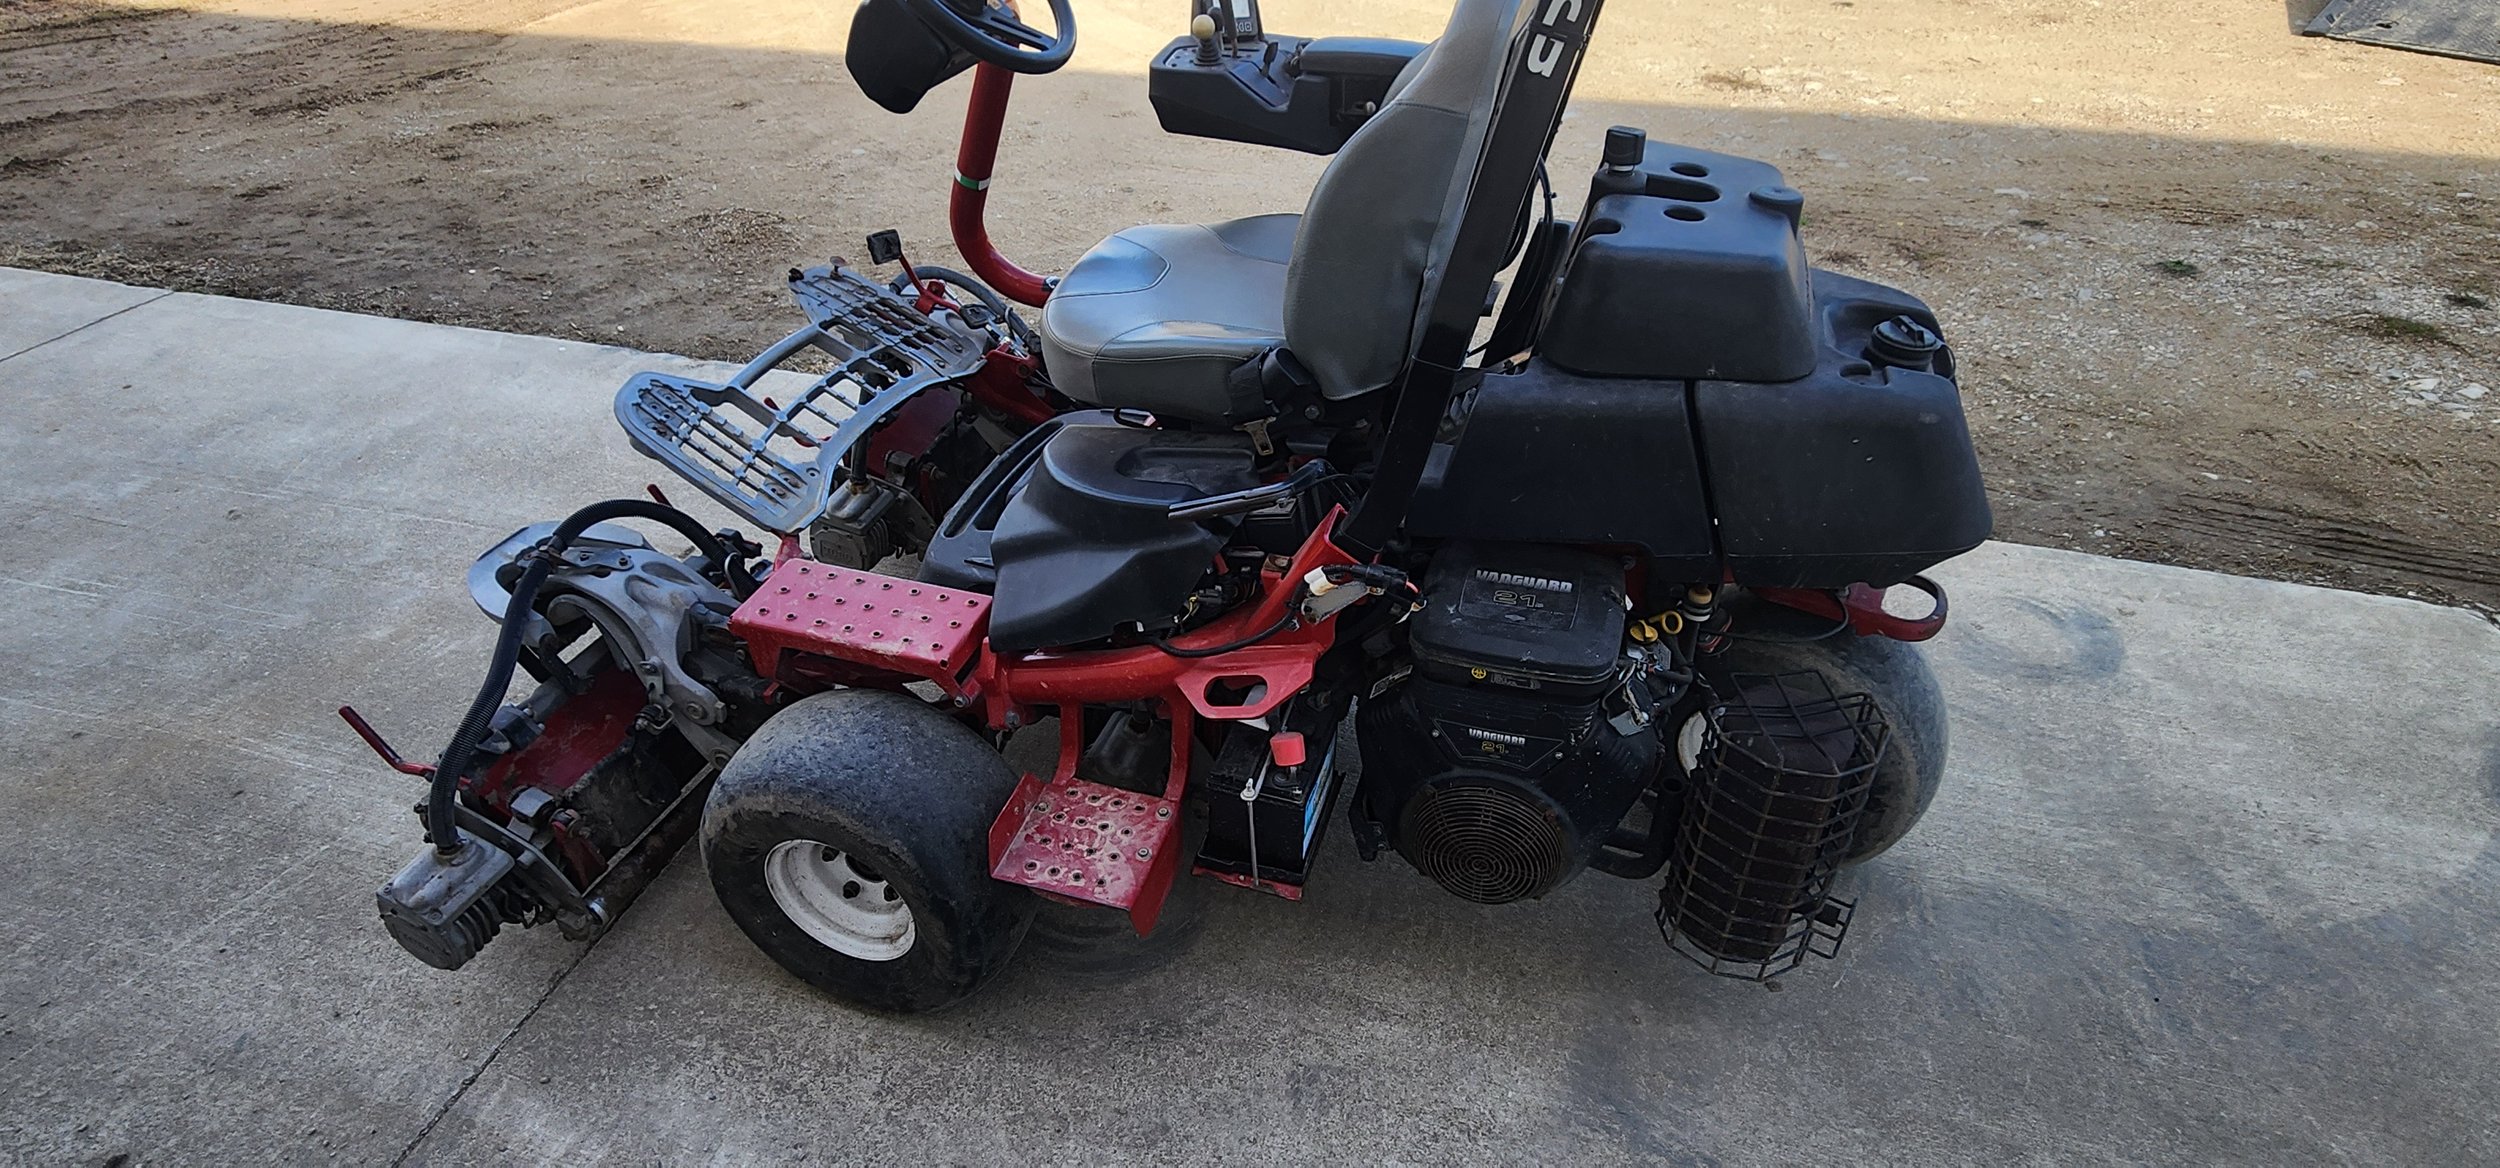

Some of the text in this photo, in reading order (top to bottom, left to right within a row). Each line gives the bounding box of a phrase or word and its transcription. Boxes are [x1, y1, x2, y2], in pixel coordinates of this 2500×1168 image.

[1476, 570, 1572, 592] VANGUARD
[1493, 590, 1536, 607] 21
[1469, 728, 1525, 744] VANGUARD
[1481, 741, 1505, 754] 21
